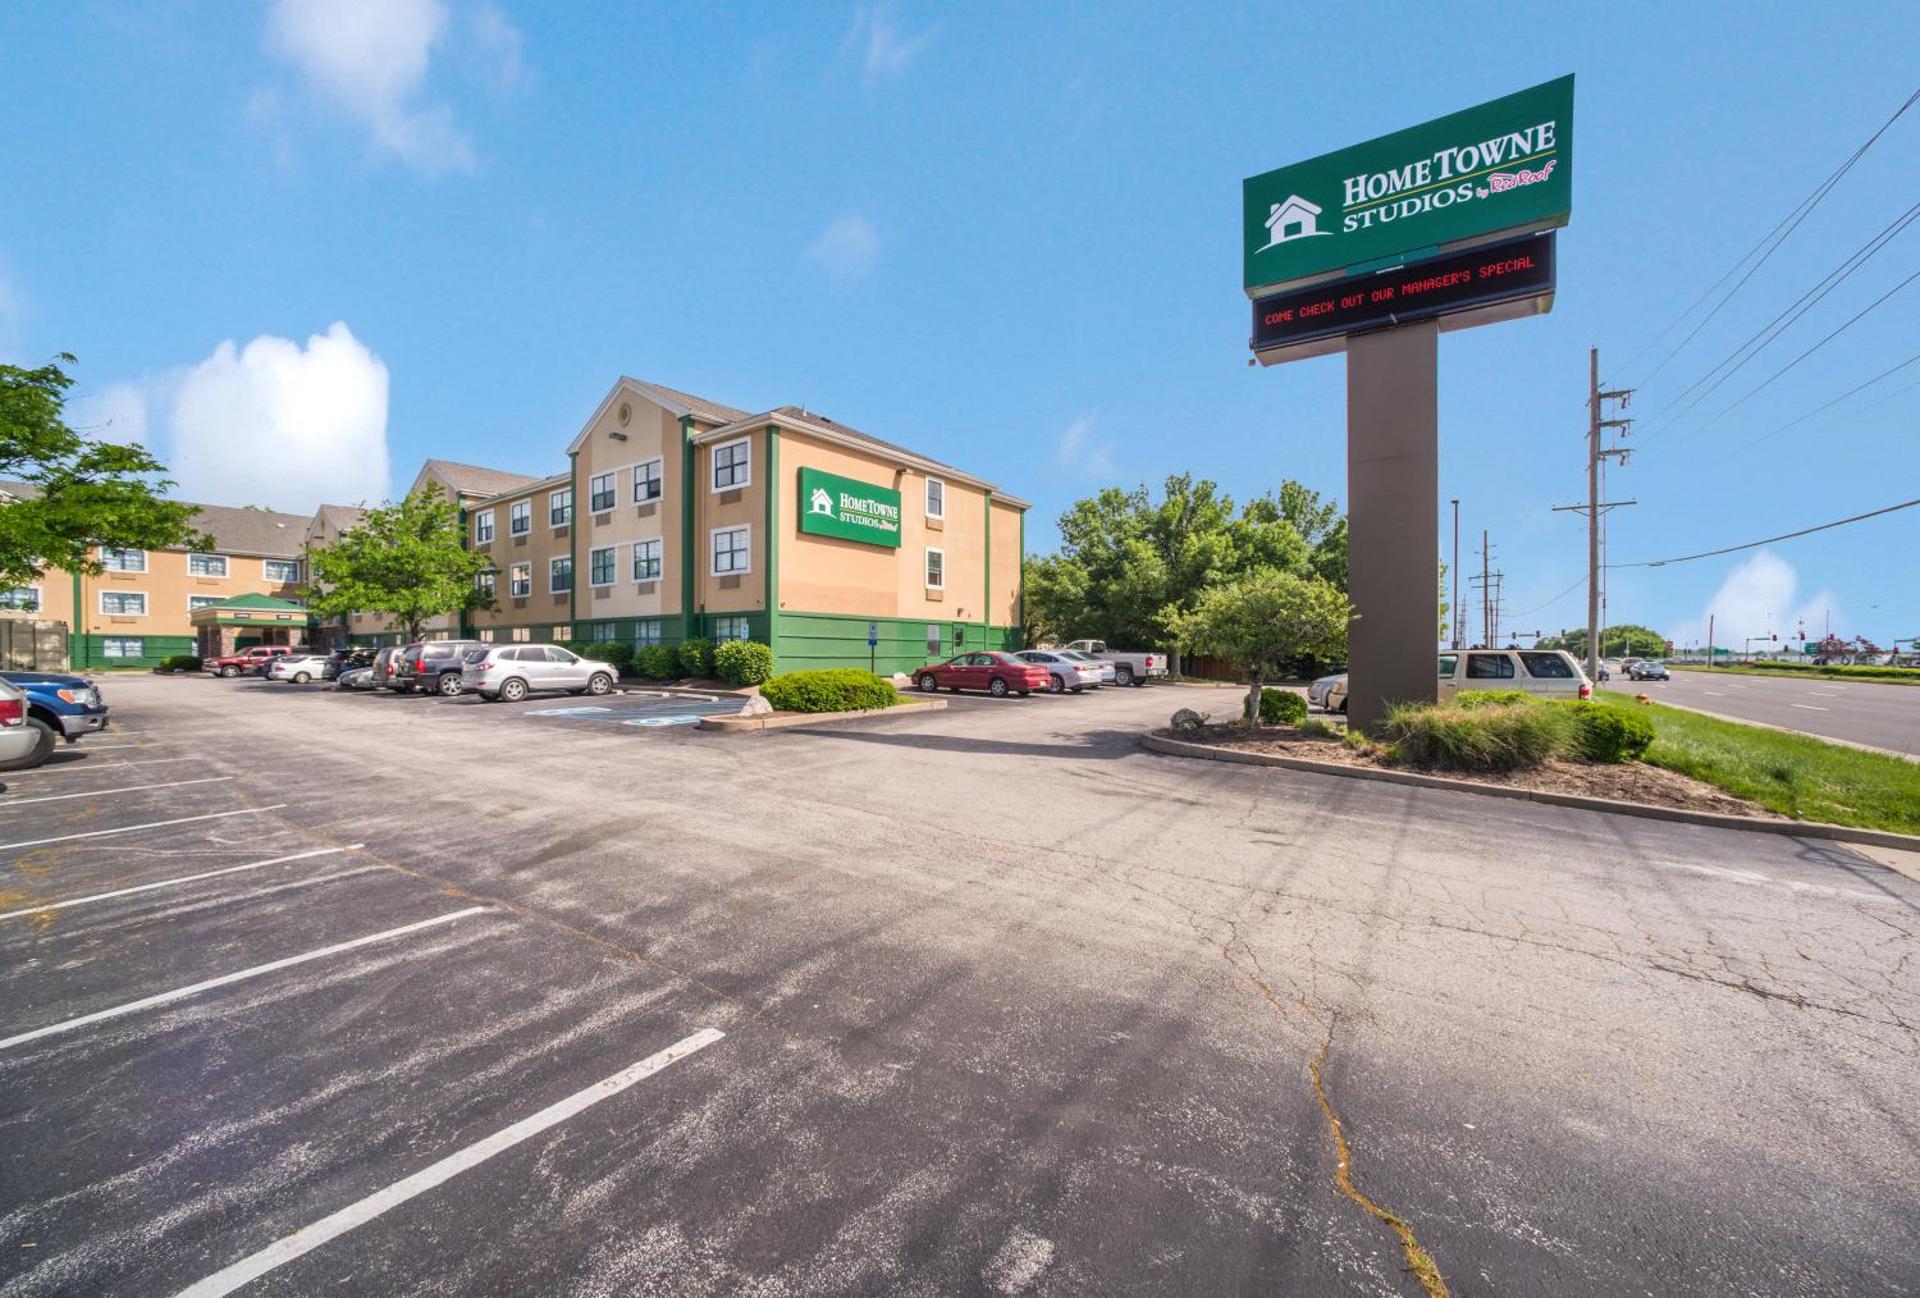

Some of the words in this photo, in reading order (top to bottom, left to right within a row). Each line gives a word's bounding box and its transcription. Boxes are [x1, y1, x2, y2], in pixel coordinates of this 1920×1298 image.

[1343, 182, 1473, 233] STUDIOS
[1516, 159, 1557, 187] Roof
[1265, 309, 1294, 326] COME
[1300, 301, 1335, 318] CHECK
[1341, 293, 1365, 309] OUT
[1371, 287, 1395, 304] OUR
[1479, 255, 1535, 279] SPECIAL
[840, 511, 879, 528] STUDIOS
